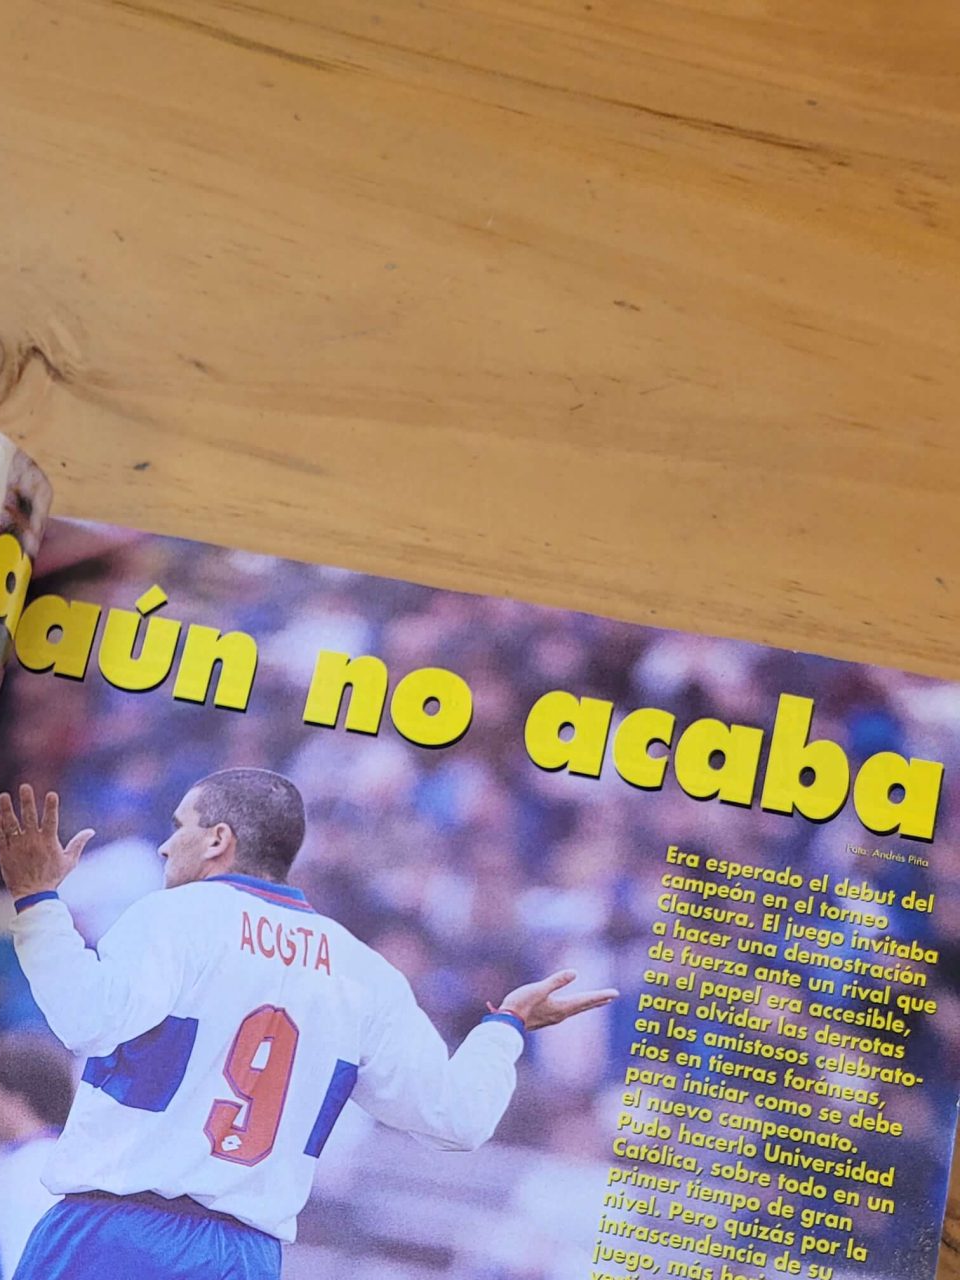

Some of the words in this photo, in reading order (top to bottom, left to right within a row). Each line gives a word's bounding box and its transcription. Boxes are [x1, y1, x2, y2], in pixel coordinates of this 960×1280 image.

[15, 583, 258, 713] aún
[303, 649, 475, 748] no
[525, 692, 945, 843] acaba
[660, 872, 758, 904] campeón
[761, 893, 790, 911] en
[793, 895, 816, 916] el
[819, 901, 889, 930] torneo
[665, 843, 702, 871] Era
[704, 857, 805, 890] esperado
[808, 875, 830, 894] el
[834, 879, 897, 906] debut
[900, 889, 937, 914] del
[651, 921, 668, 937] a
[672, 919, 732, 949] hacer
[736, 938, 779, 959] una
[783, 942, 929, 989] demostración
[657, 891, 756, 930] Clausura.
[760, 912, 782, 933] El
[784, 916, 845, 949] juego
[851, 931, 941, 967] invitaba
[634, 1018, 661, 1035] en
[666, 1017, 697, 1043] los
[703, 1032, 810, 1068] amistosos
[814, 1053, 924, 1090] celebrato-
[638, 994, 691, 1017] para
[695, 1001, 773, 1034] olvidar
[776, 1015, 809, 1042] las
[813, 1023, 907, 1061] derrotas
[203, 1003, 300, 1167] 9
[630, 1038, 671, 1064] rios
[674, 1051, 703, 1069] en
[708, 1051, 778, 1087] tierras
[782, 1067, 888, 1111] foráneas,
[617, 1110, 673, 1141] Pudo
[677, 1123, 758, 1159] hacerlo
[763, 1141, 897, 1190] Universidad
[621, 1087, 642, 1108] el
[647, 1097, 714, 1124] nuevo
[718, 1112, 859, 1155] campeonato.
[603, 1192, 660, 1218] nivel.
[668, 1200, 719, 1230] Pero
[723, 1218, 795, 1247] quizás
[800, 1235, 841, 1257] por
[845, 1237, 869, 1264] la
[607, 1167, 681, 1193] primer
[686, 1180, 762, 1213] tiempo
[766, 1195, 796, 1221] de
[800, 1208, 854, 1234] gran
[591, 1240, 660, 1273] juego,
